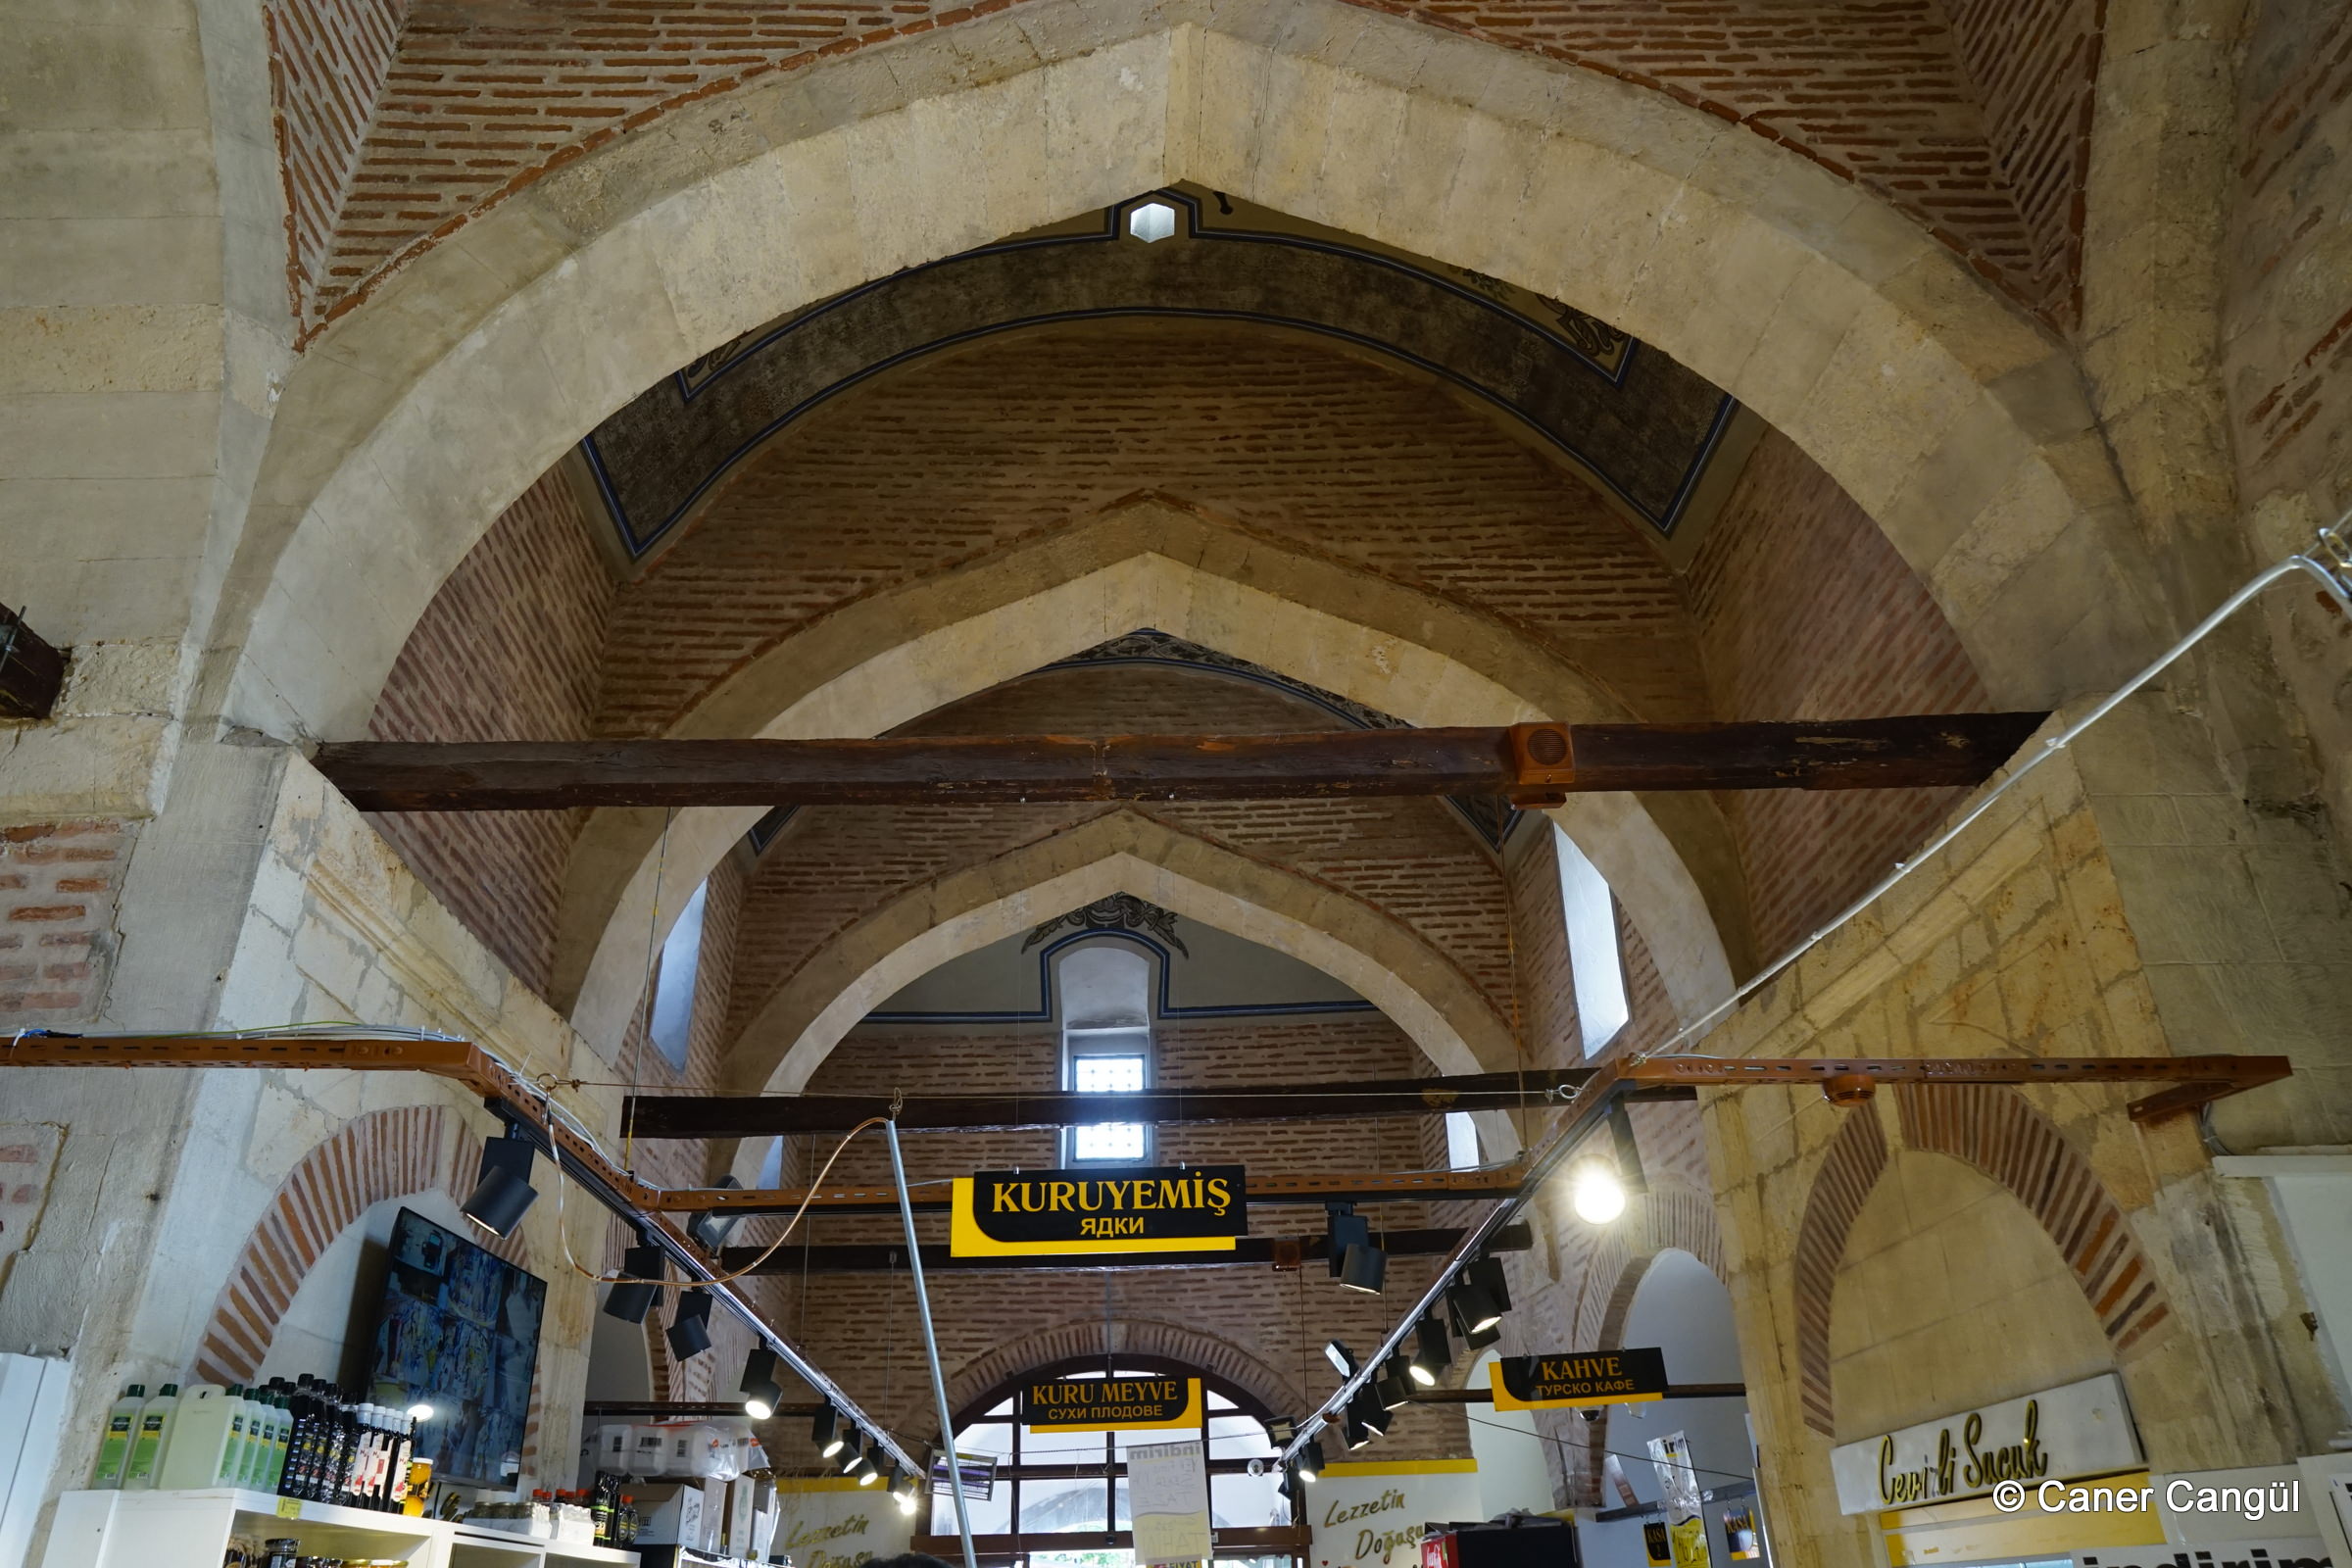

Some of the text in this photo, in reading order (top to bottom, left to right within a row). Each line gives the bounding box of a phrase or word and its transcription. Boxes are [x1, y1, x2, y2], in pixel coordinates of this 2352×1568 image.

[993, 1171, 1231, 1216] KURUYEMİŞ
[1080, 1217, 1145, 1238] ЯДКИ
[1541, 1356, 1623, 1381] KAHVE
[1032, 1381, 1178, 1405] KURU MEYVE
[1536, 1379, 1636, 1396] ТУРСКО КАФЕ
[1048, 1404, 1163, 1420] СУХИ ПЛОДОВЕ
[1962, 1399, 2048, 1489] Sucuk
[1324, 1489, 1405, 1528] Lezzetin
[786, 1514, 869, 1548] Lezzetin
